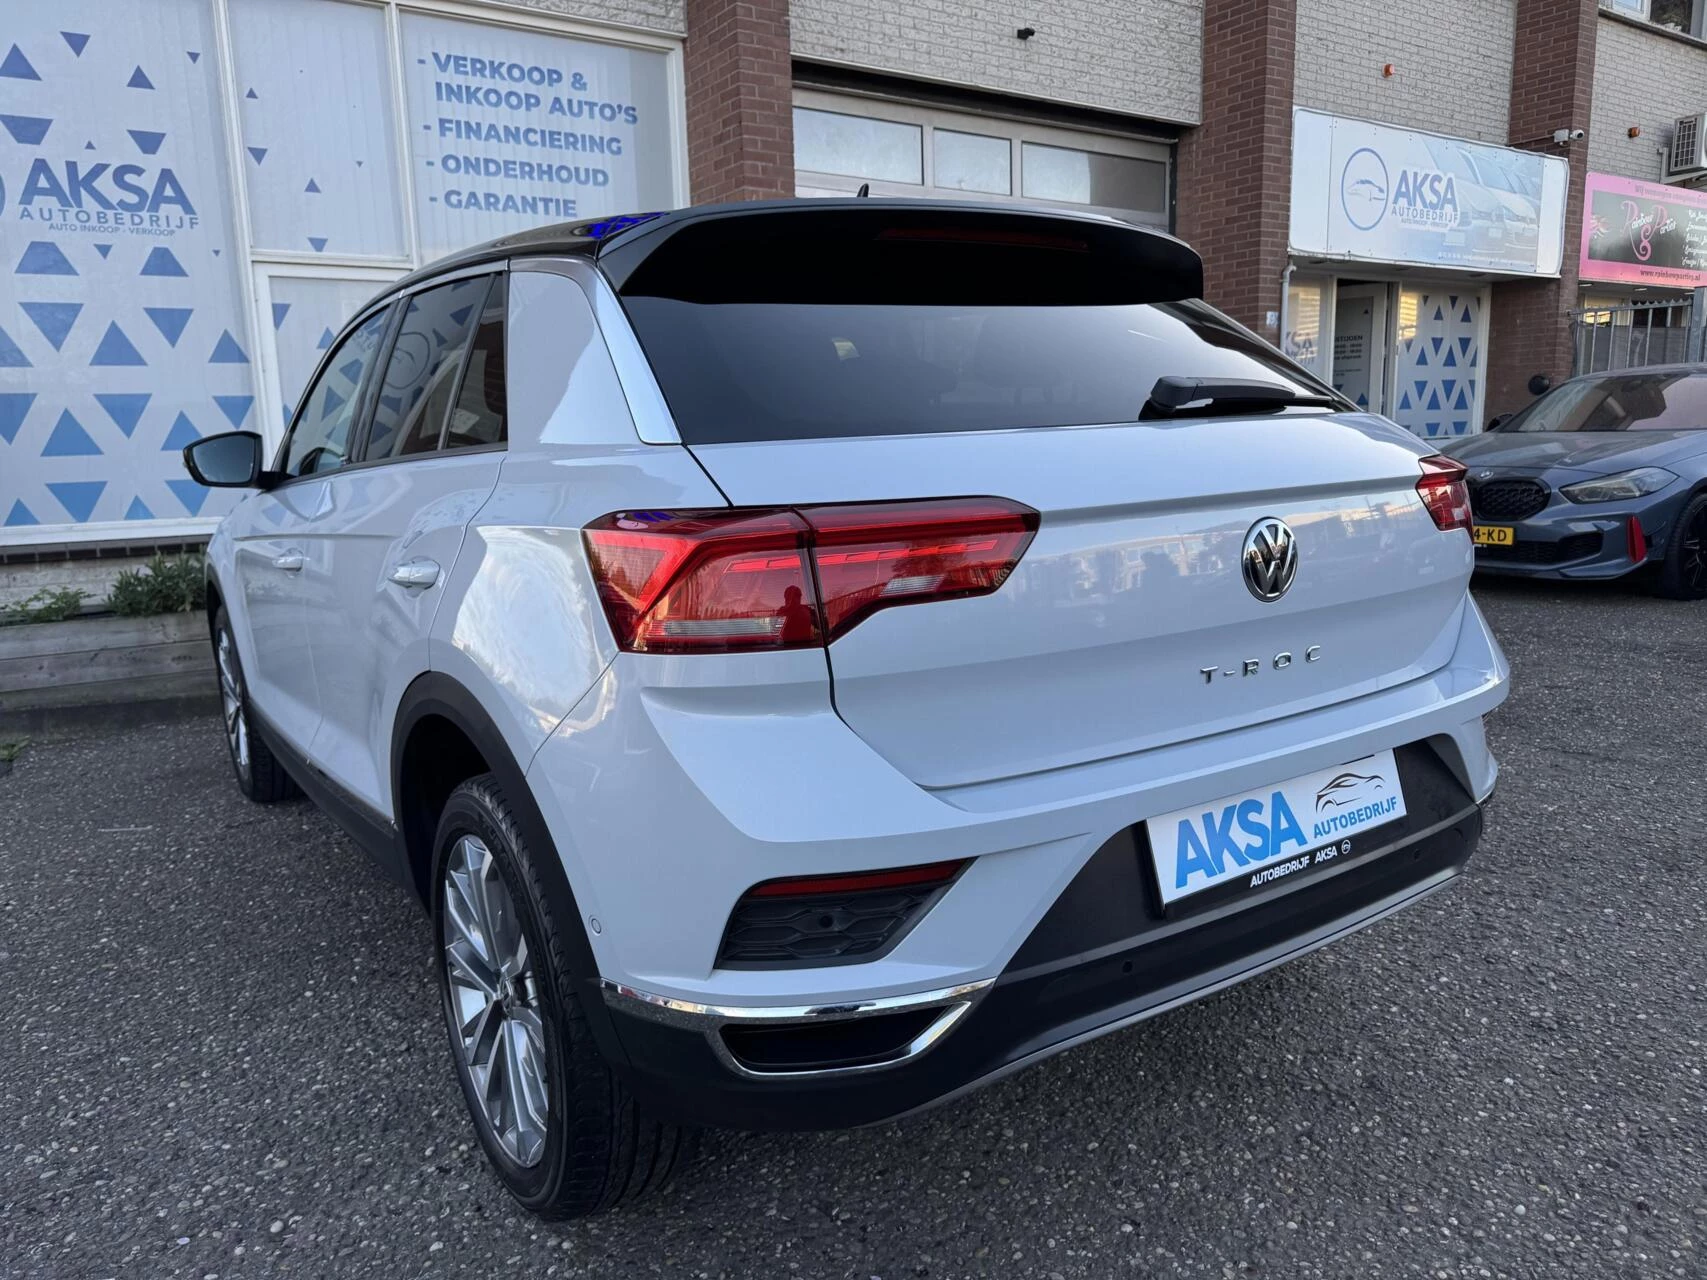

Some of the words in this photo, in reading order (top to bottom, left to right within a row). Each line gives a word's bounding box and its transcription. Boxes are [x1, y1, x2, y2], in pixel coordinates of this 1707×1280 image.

[432, 51, 563, 87] VERKOOP
[571, 72, 588, 91] &
[435, 81, 541, 112] INKOOP
[438, 117, 623, 156] FINANCIERING
[18, 157, 197, 216] AKSA
[441, 154, 609, 187] ONDERHOUD
[444, 189, 578, 218] GARANTIE
[1392, 169, 1458, 213] AKSA
[19, 206, 200, 230] AUTOBEDRIJF
[48, 223, 77, 232] AUTO
[80, 225, 120, 235] INKOOP
[129, 227, 176, 237] VERKOOP
[1391, 204, 1459, 224] AUTOBEDRIJF
[1200, 645, 1321, 684] T-ROC
[1176, 791, 1308, 889] AKSA
[1313, 796, 1397, 839] AUTOBEDRIJF
[1250, 856, 1310, 888] AUTOBEDRIJF
[1314, 846, 1338, 864] AKSA
